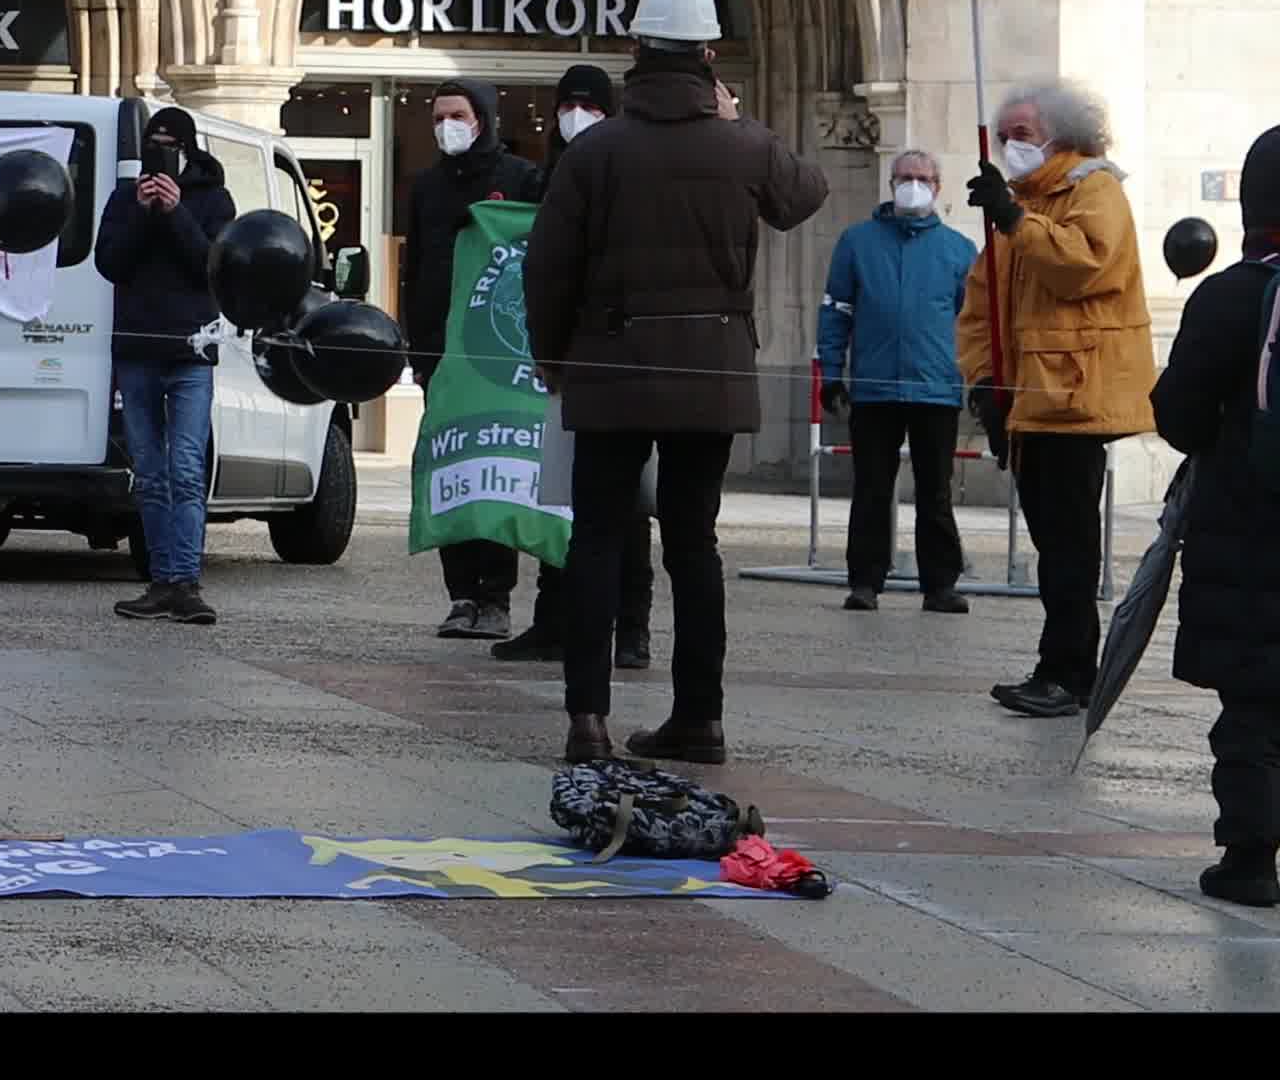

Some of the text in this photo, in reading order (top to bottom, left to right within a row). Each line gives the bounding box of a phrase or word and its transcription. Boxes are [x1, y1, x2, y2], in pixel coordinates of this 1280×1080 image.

[431, 423, 547, 460] Wir strei
[440, 473, 471, 502] bis
[480, 465, 521, 494] Ihr
